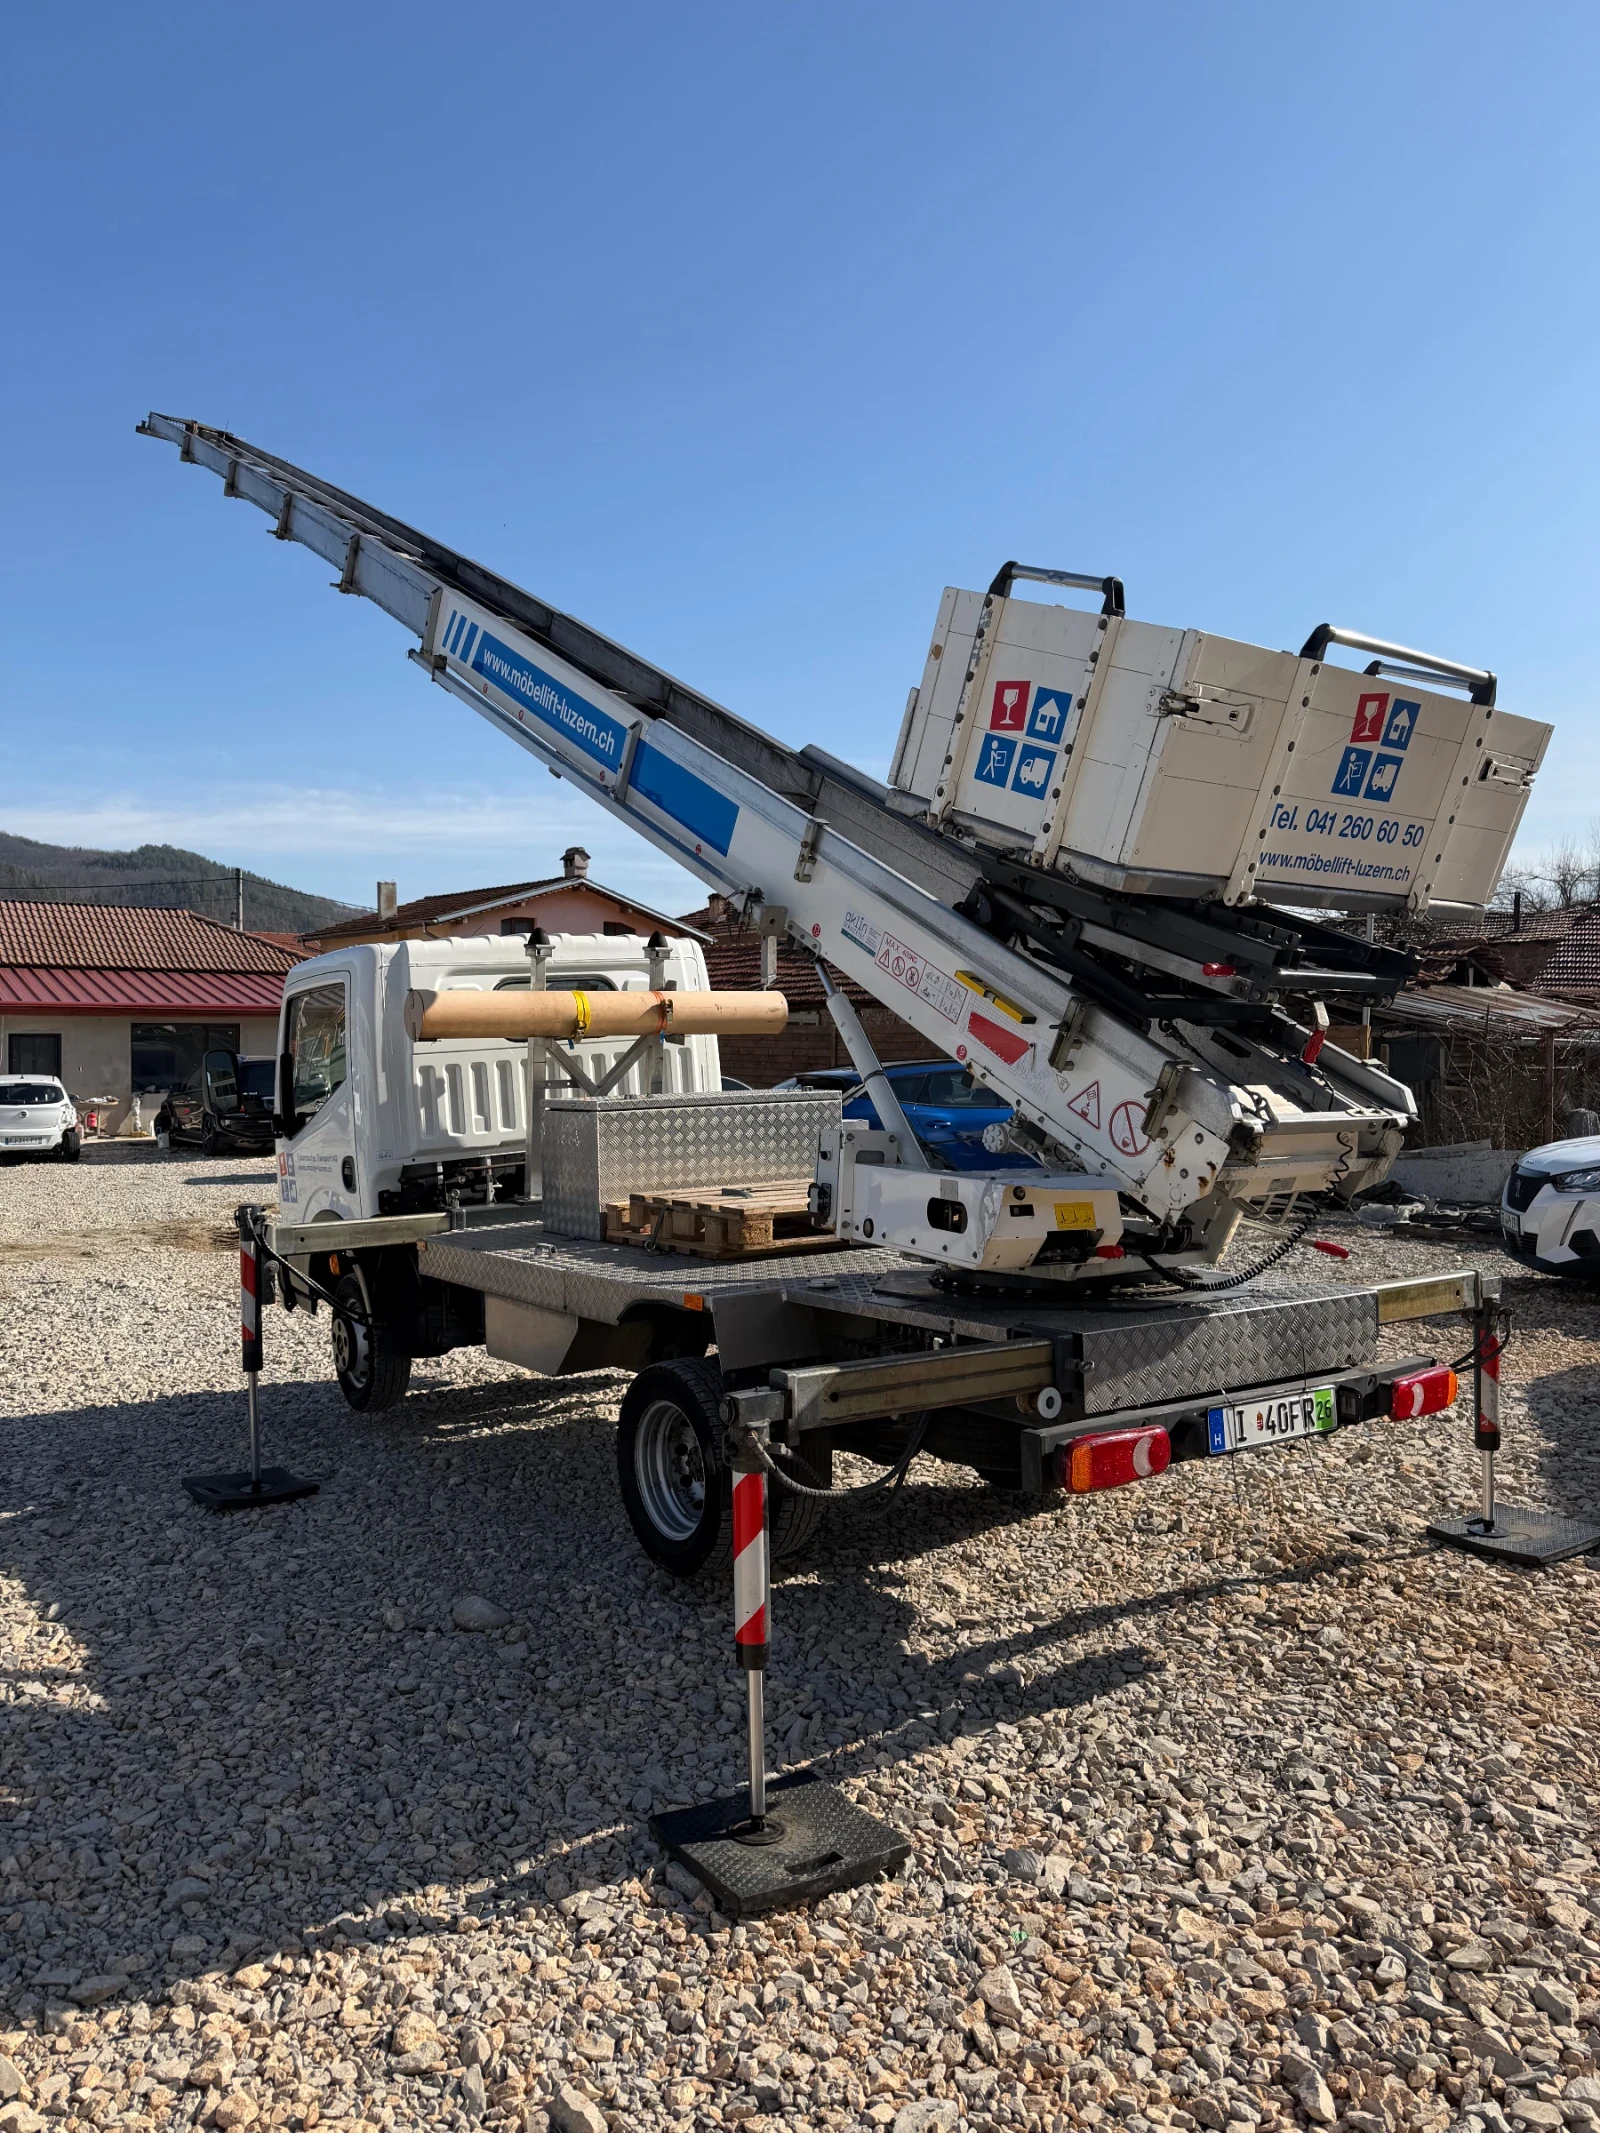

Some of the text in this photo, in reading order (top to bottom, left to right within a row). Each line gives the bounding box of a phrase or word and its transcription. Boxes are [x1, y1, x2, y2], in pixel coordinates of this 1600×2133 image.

[483, 648, 615, 756] www.möbellift-luzern.ch
[1269, 803, 1425, 848] Tel. 041 260 60 50
[885, 936, 901, 952] MAX
[1315, 1397, 1332, 1422] 26
[1214, 1433, 1222, 1446] H
